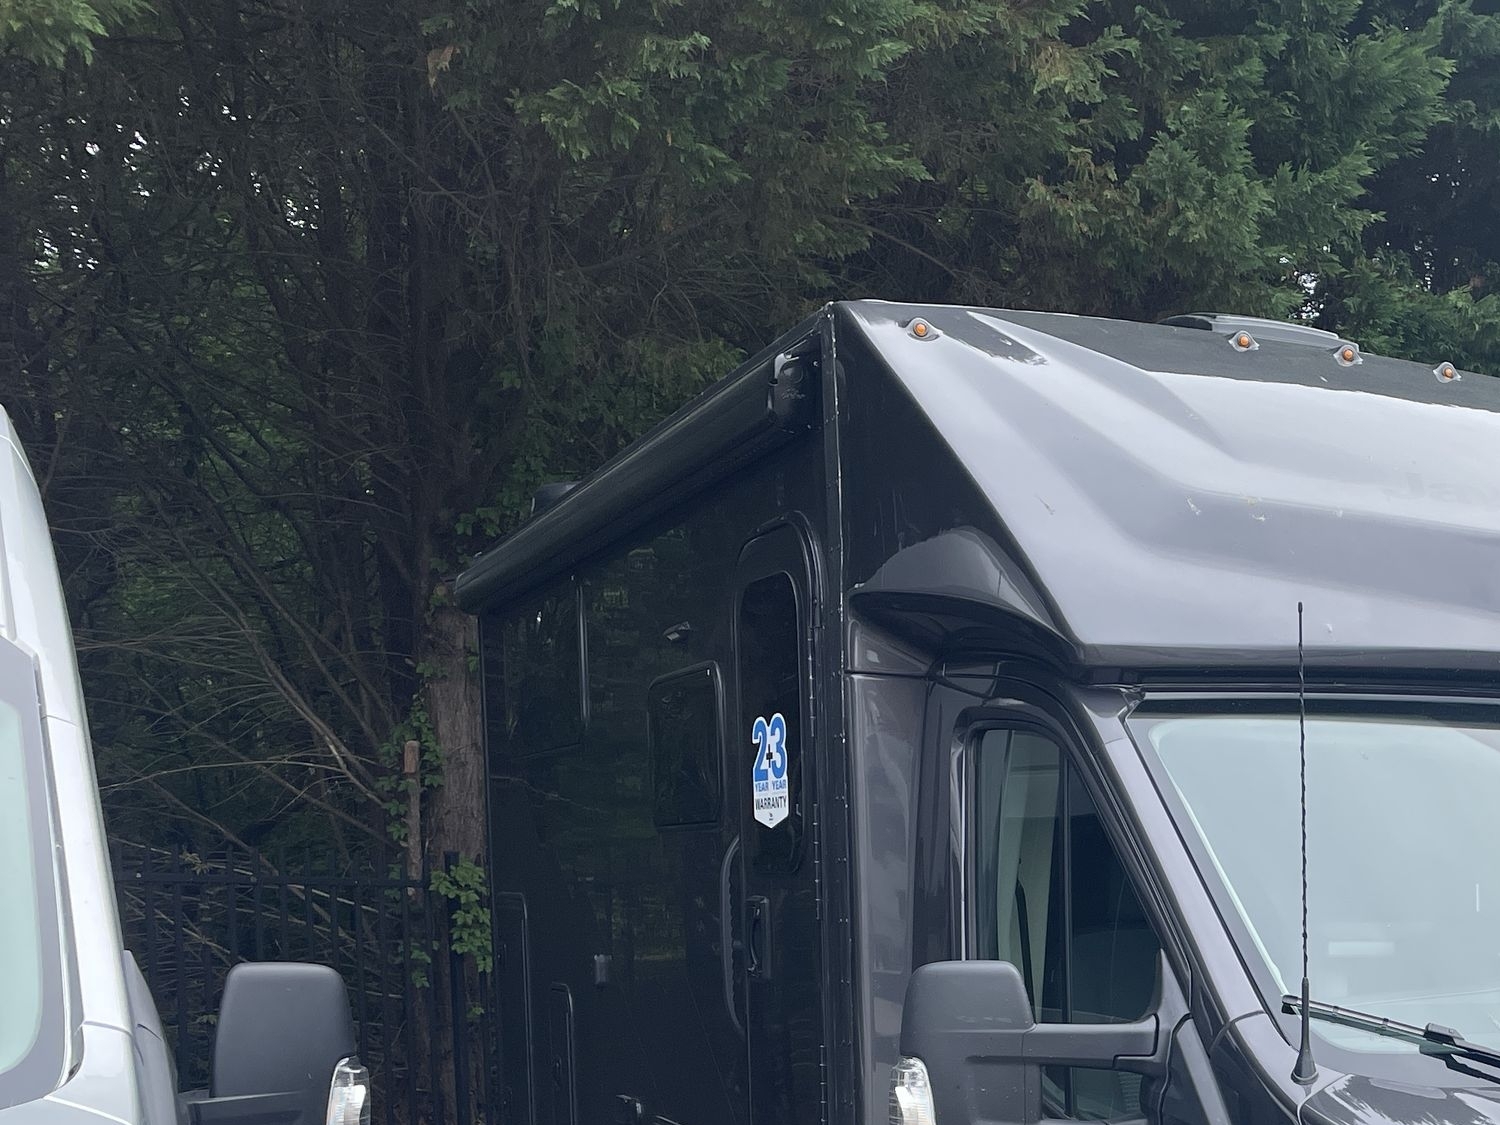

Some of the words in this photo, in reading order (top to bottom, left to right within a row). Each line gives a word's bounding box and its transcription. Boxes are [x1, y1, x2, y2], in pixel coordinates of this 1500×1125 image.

[755, 782, 769, 792] YEAR
[772, 779, 787, 790] YEAR
[755, 796, 787, 810] WARRANTY
